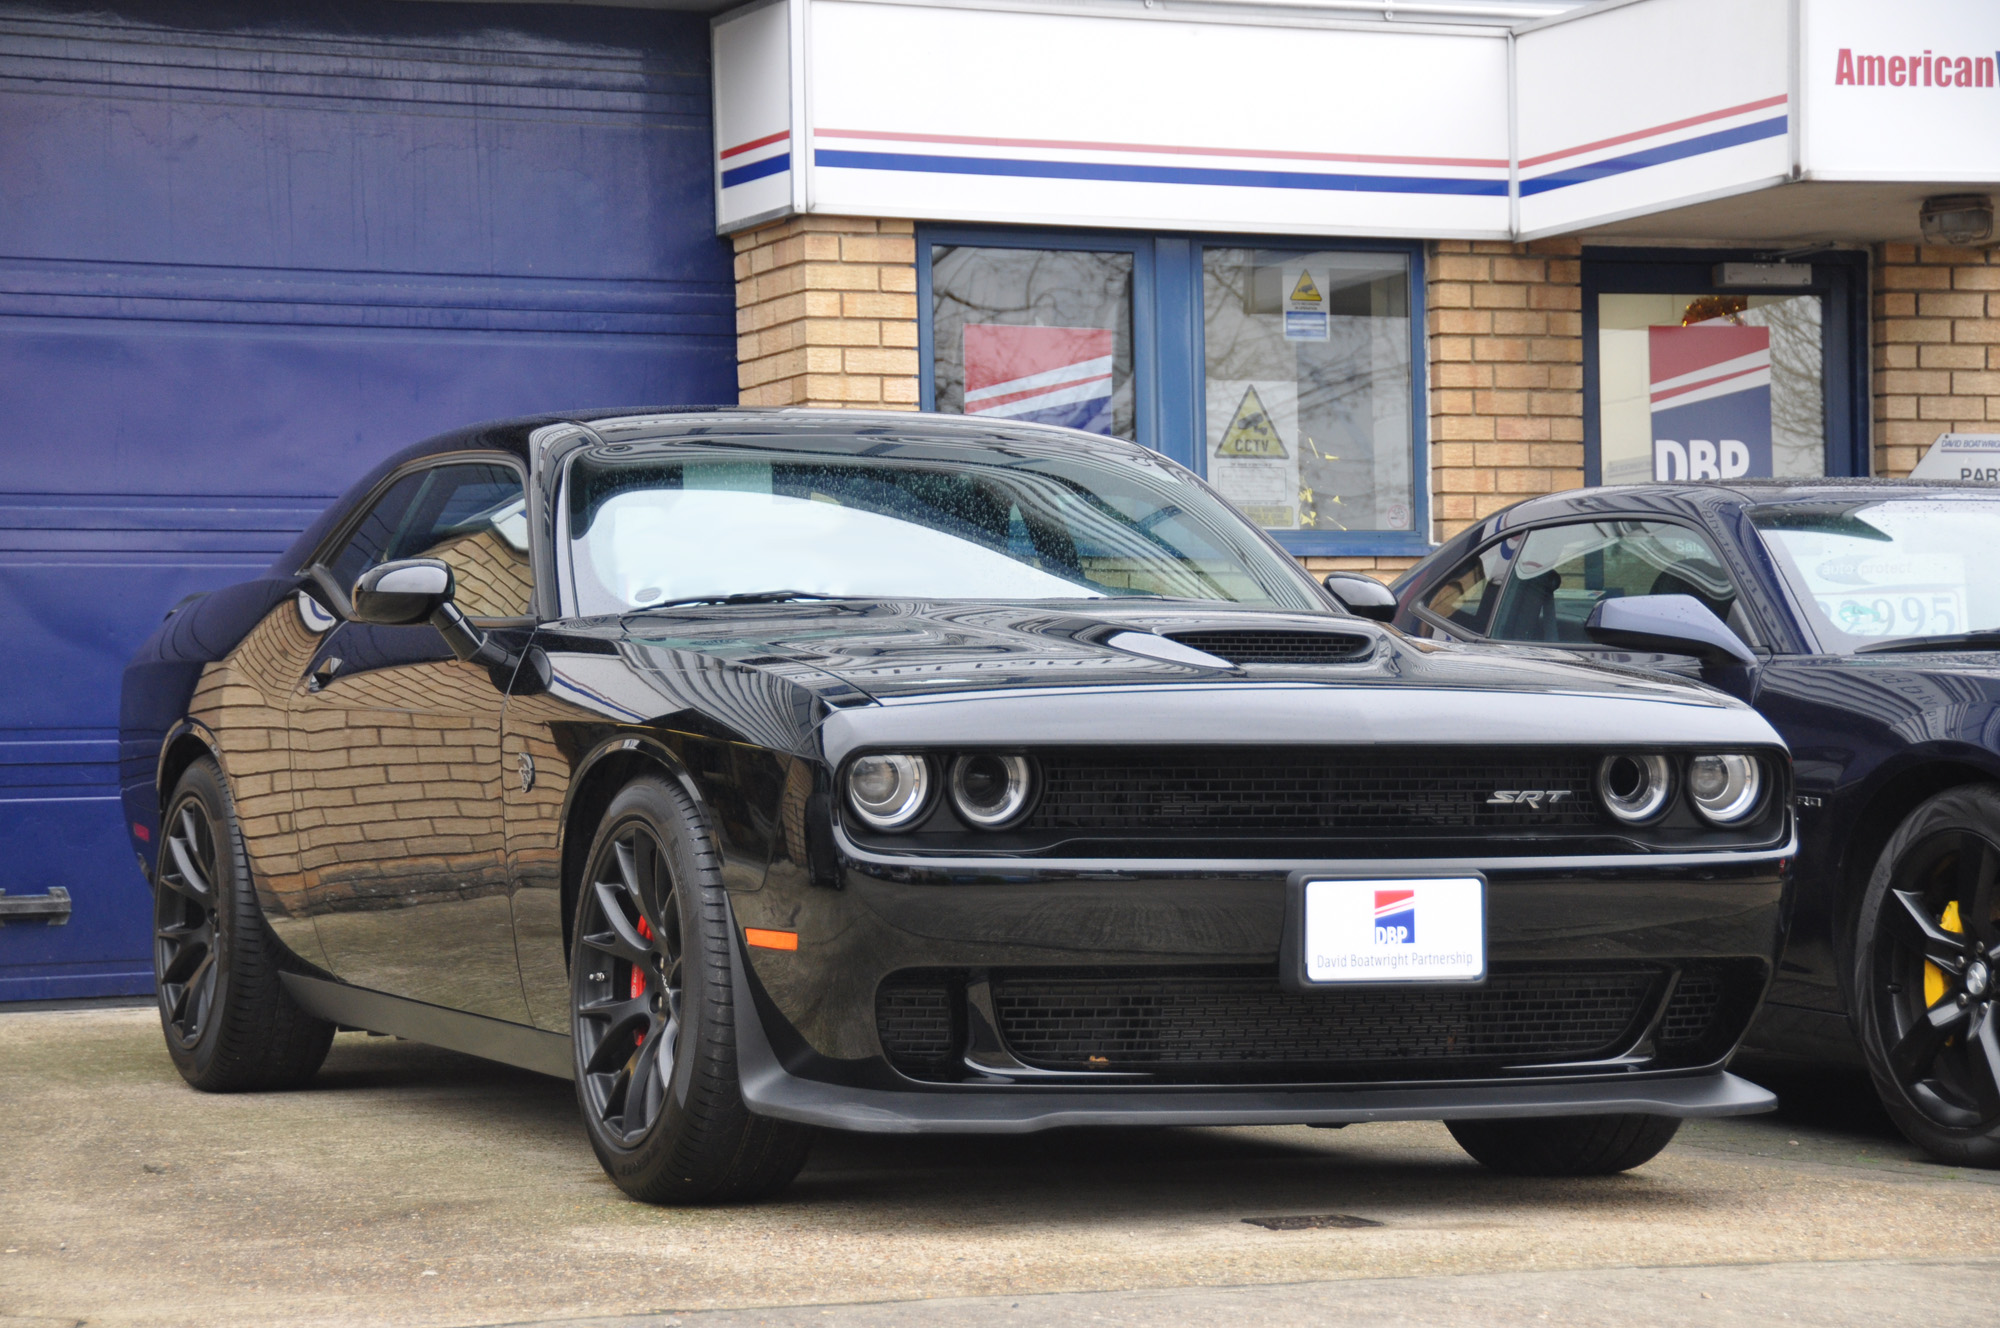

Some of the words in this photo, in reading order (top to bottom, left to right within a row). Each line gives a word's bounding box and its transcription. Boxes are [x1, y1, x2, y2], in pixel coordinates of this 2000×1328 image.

[1835, 48, 1994, 88] American
[1235, 438, 1269, 452] CCTV
[1941, 439, 1962, 448] DAVID
[1655, 439, 1750, 481] DBP
[1861, 562, 1912, 577] protect
[1486, 790, 1572, 809] SRT
[1375, 926, 1408, 944] DBP
[1317, 954, 1347, 968] David
[1350, 953, 1409, 969] Boatwright
[1412, 951, 1473, 967] Partnership
